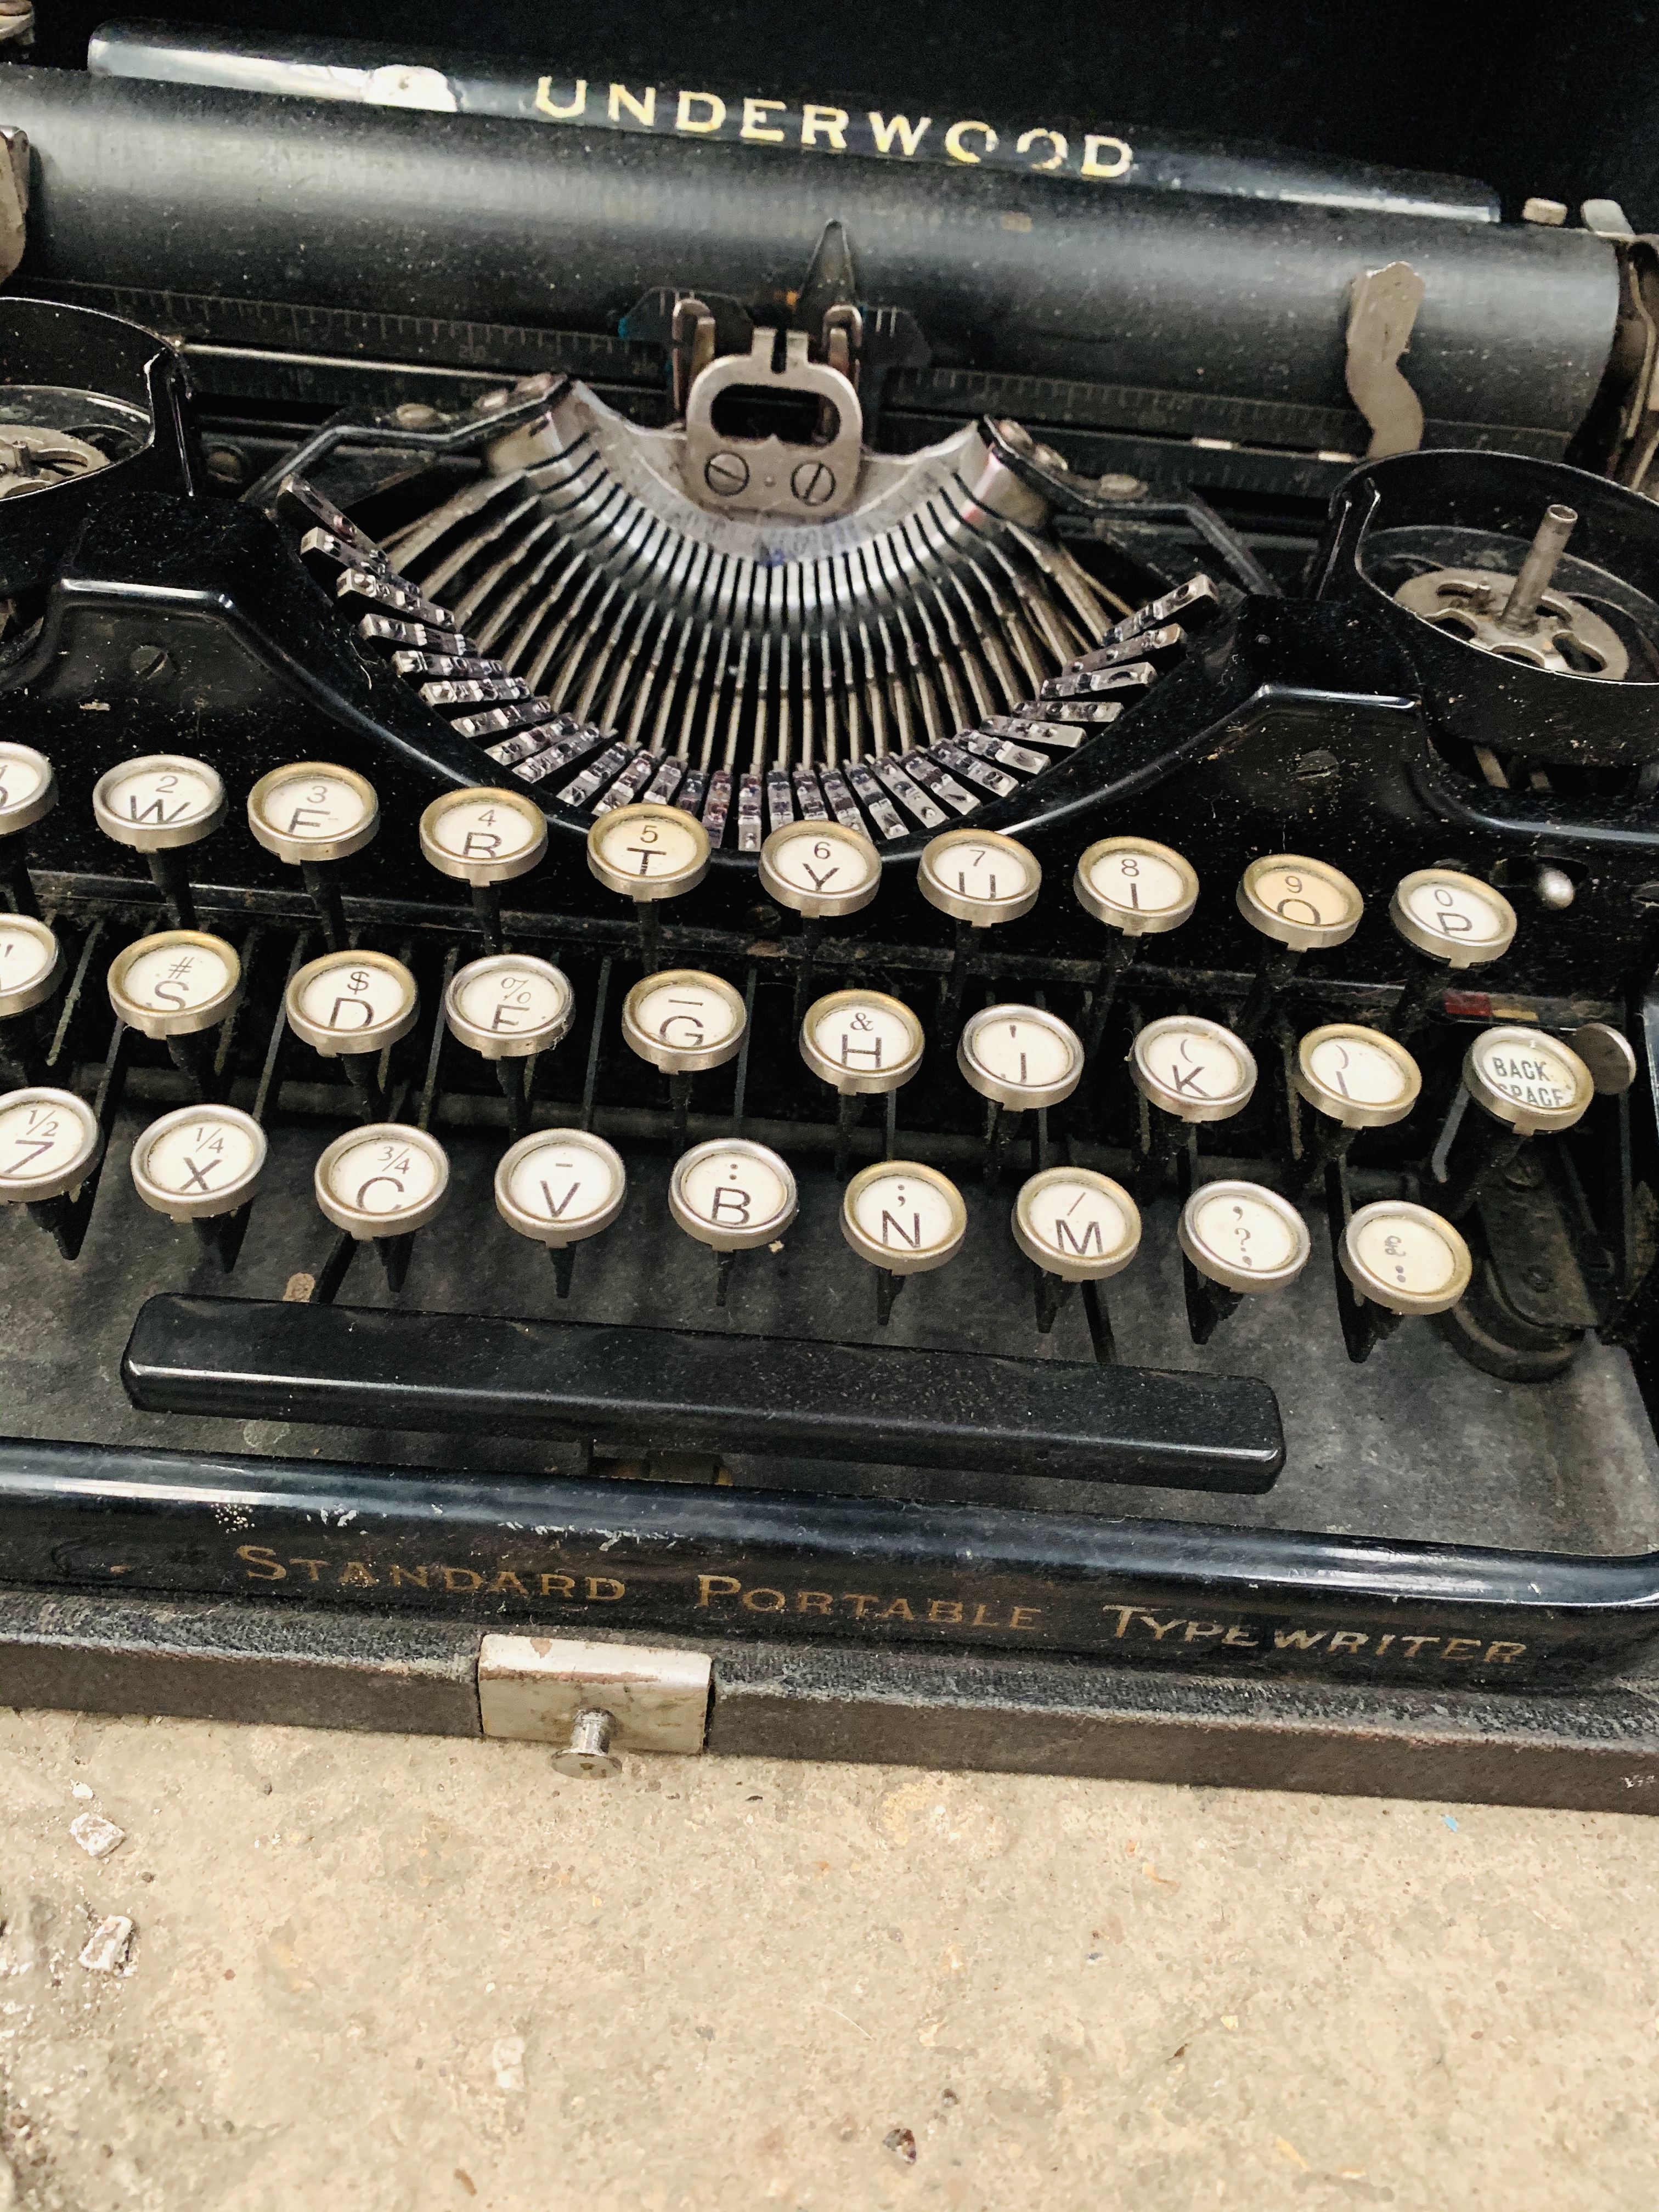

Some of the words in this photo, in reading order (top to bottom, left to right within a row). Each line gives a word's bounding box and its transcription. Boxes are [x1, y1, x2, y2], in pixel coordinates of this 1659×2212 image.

[535, 75, 1134, 178] UNDERWOOD
[155, 775, 178, 794] 2
[306, 785, 328, 804] 3
[129, 795, 191, 823] W
[478, 809, 496, 827] 4
[462, 832, 501, 858] R
[640, 825, 658, 843] 5
[627, 847, 667, 876] T
[814, 842, 831, 860] 6
[970, 849, 986, 867] 7
[802, 863, 839, 891] Y
[1121, 859, 1139, 877] 8
[1130, 883, 1139, 909] I
[1284, 876, 1303, 894] 9
[1436, 912, 1472, 935] P
[145, 980, 189, 1010] S
[347, 971, 369, 995] $
[500, 977, 532, 1003] %
[329, 997, 374, 1028] D
[850, 1013, 872, 1031] &
[659, 1015, 704, 1047] G
[841, 1034, 882, 1069] H
[1172, 1065, 1209, 1097] K
[1492, 1057, 1550, 1082] BACK
[180, 1158, 222, 1191] X
[357, 1176, 404, 1210] C
[540, 1181, 580, 1218] V
[712, 1187, 751, 1226] B
[882, 1210, 921, 1249] N
[1055, 1219, 1103, 1257] M
[1234, 1228, 1251, 1252] ?
